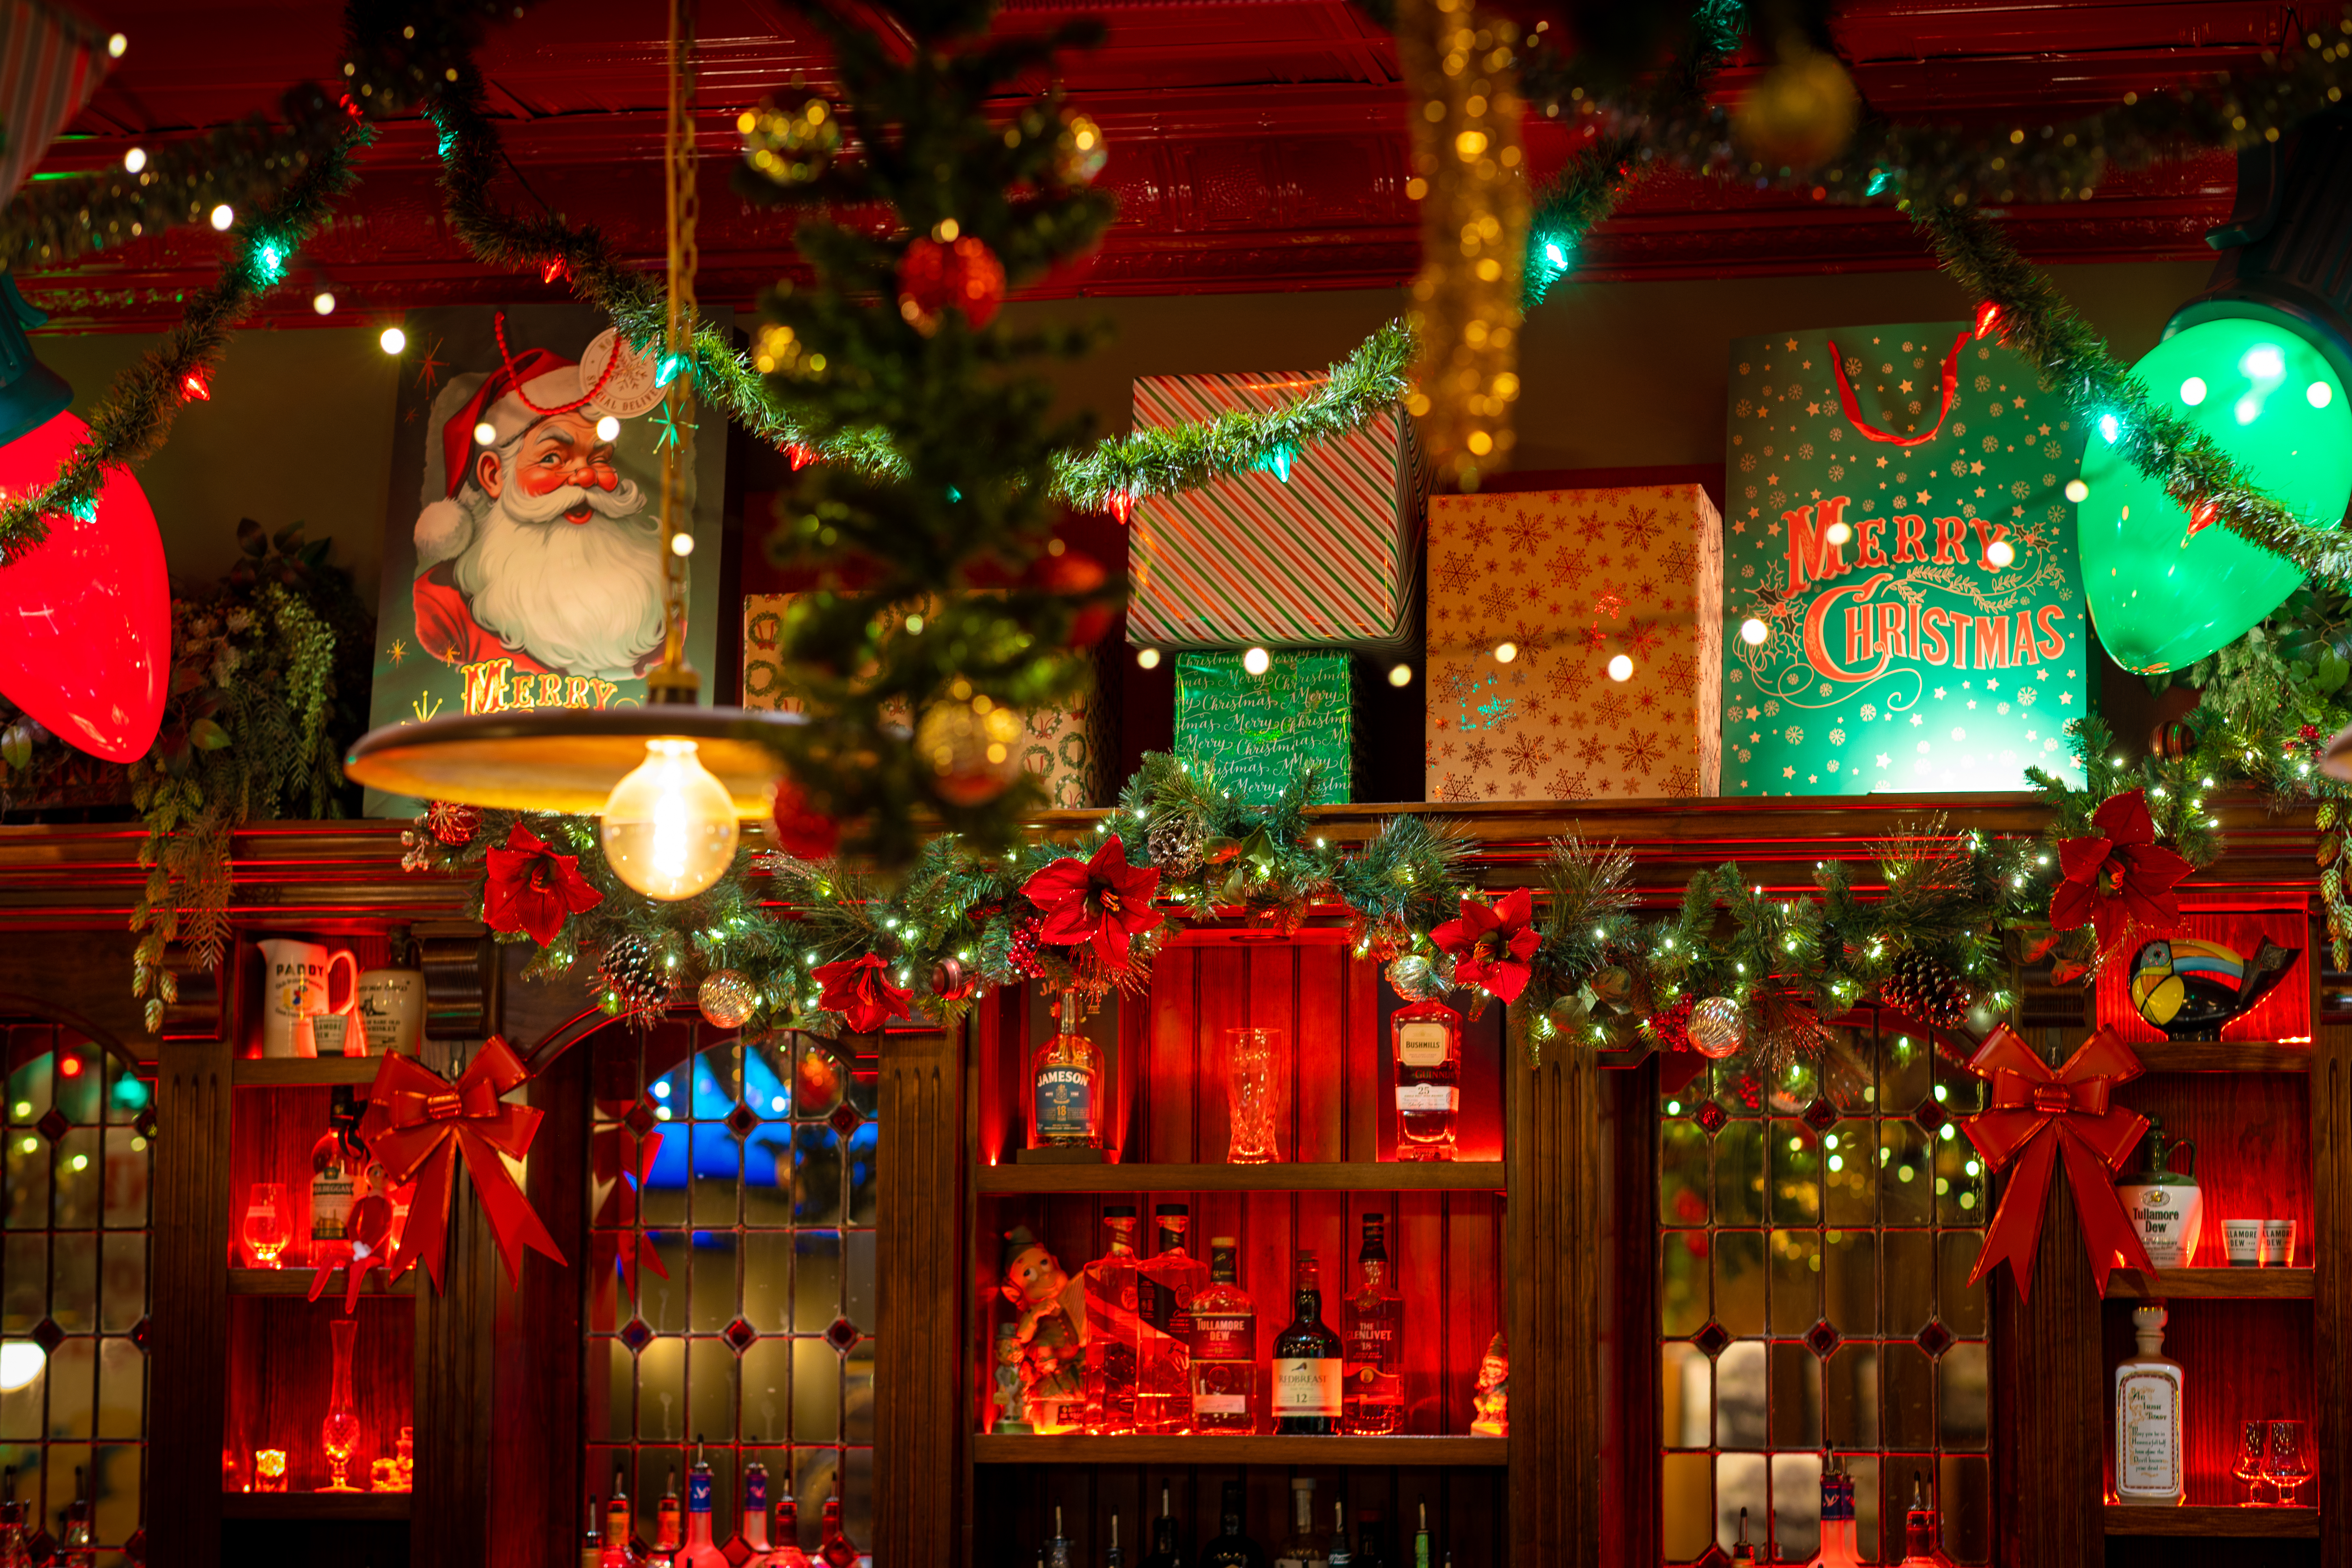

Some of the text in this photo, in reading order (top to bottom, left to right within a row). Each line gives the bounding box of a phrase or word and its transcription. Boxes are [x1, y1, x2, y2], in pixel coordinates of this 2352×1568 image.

[1780, 495, 2012, 599] MERRY
[1803, 572, 2066, 683] CHRISTMAS
[460, 657, 618, 717] MERRY
[1202, 689, 1278, 712] Christmas
[1224, 713, 1280, 735] Merry
[1177, 733, 1233, 755] Merry
[276, 964, 323, 977] PADDY
[1037, 1071, 1090, 1087] JAMESON
[1418, 1086, 1430, 1095] 25
[1057, 1105, 1067, 1116] 18
[2133, 1207, 2179, 1220] Tullamore
[2145, 1220, 2167, 1233] Dew
[1196, 1318, 1245, 1331] TULLAMORE
[1209, 1331, 1230, 1341] DEW
[1345, 1330, 1392, 1341] GLENLIVET
[1279, 1374, 1328, 1383] REDBREAST
[1296, 1393, 1307, 1403] 12
